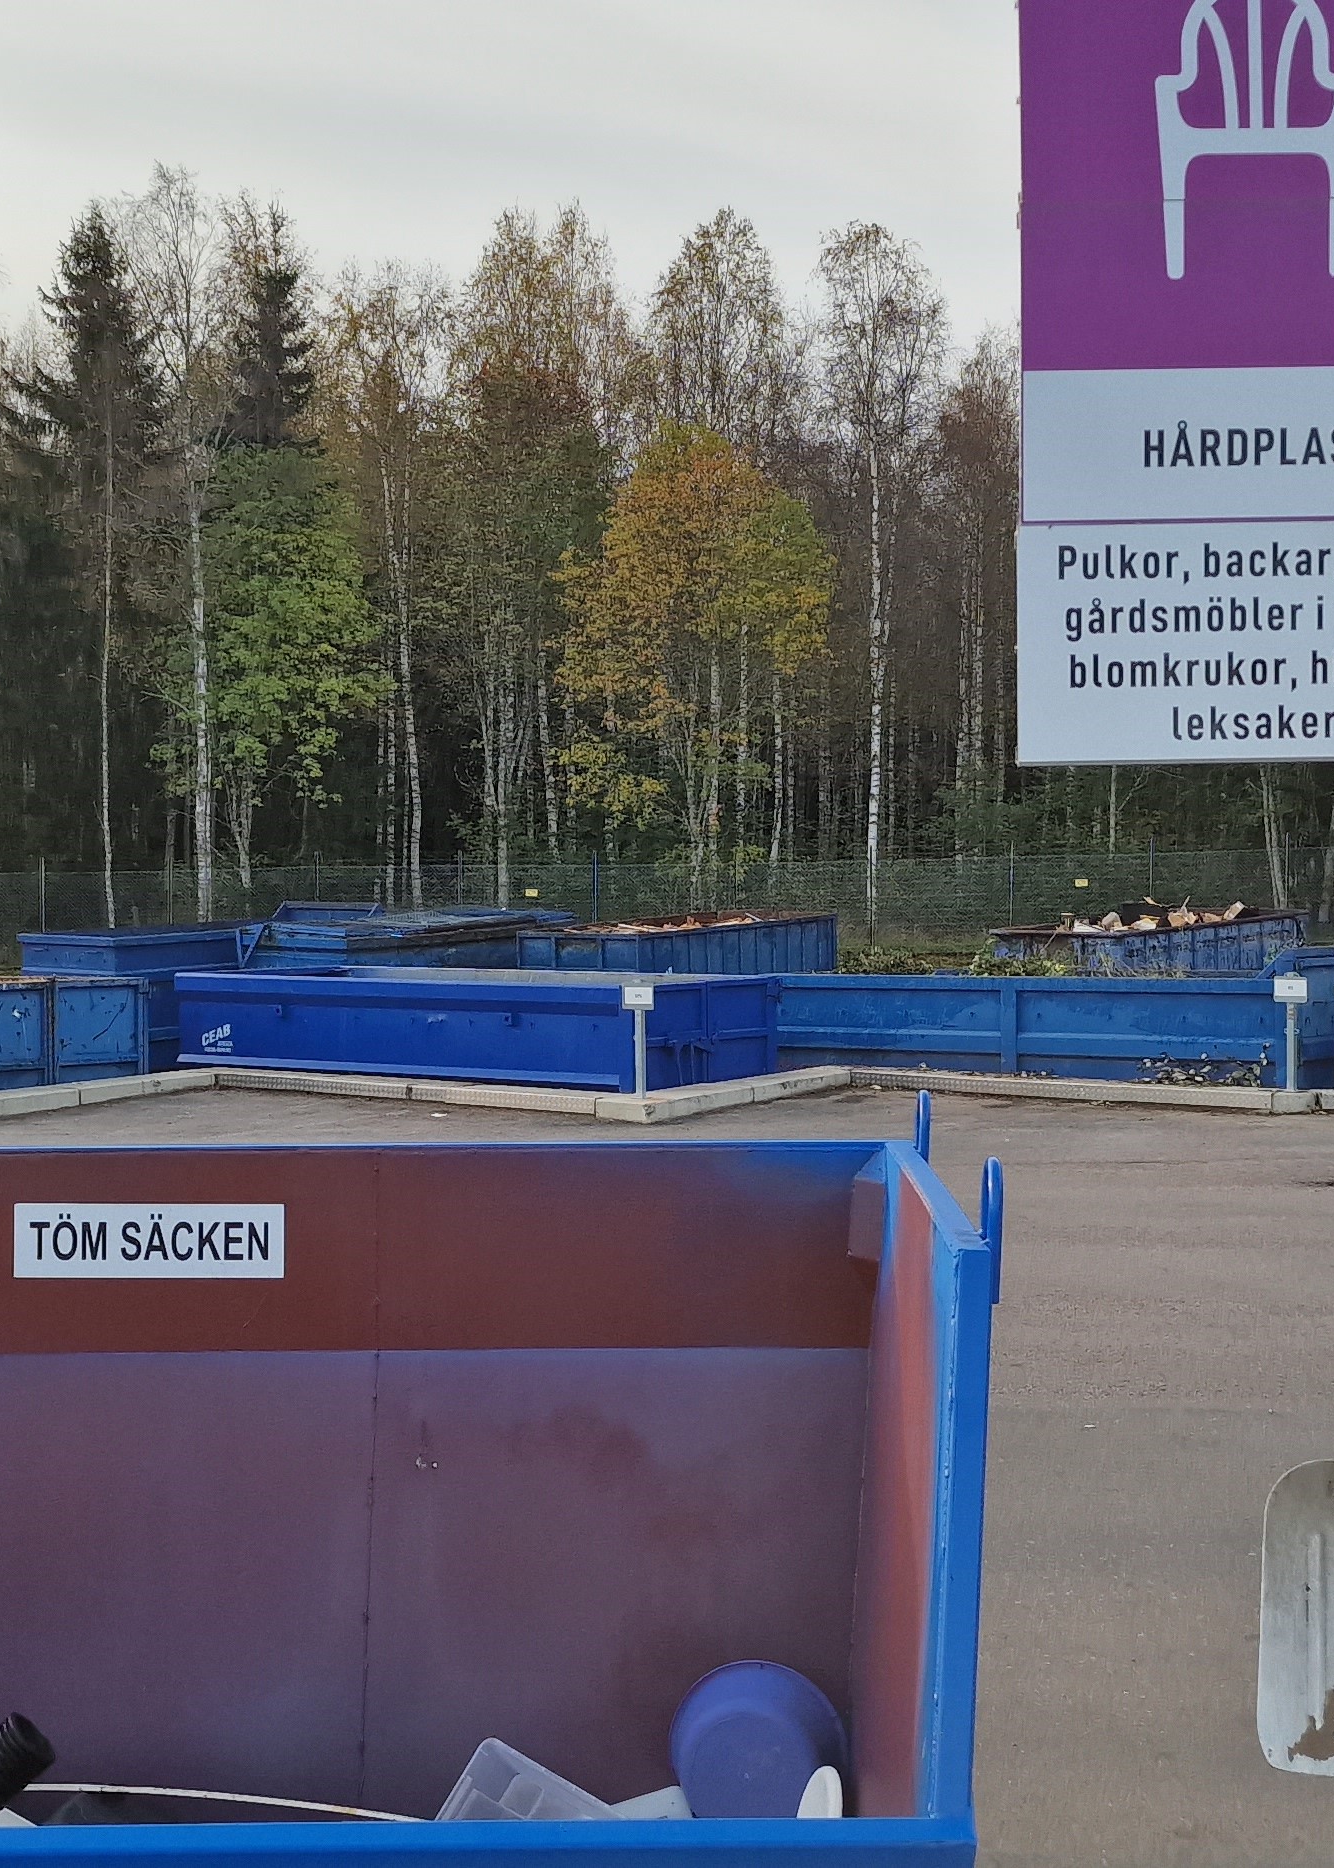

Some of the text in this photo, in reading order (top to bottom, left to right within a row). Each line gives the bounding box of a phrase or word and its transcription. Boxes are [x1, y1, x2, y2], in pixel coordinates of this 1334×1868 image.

[1058, 544, 1190, 585] Pulkor,
[1065, 597, 1304, 643] gårdsmöbler
[1316, 595, 1324, 630] i
[1069, 651, 1297, 691] blomkrukor,
[202, 1023, 231, 1047] CEAB
[29, 1213, 269, 1261] TÖM SÄCKEN
